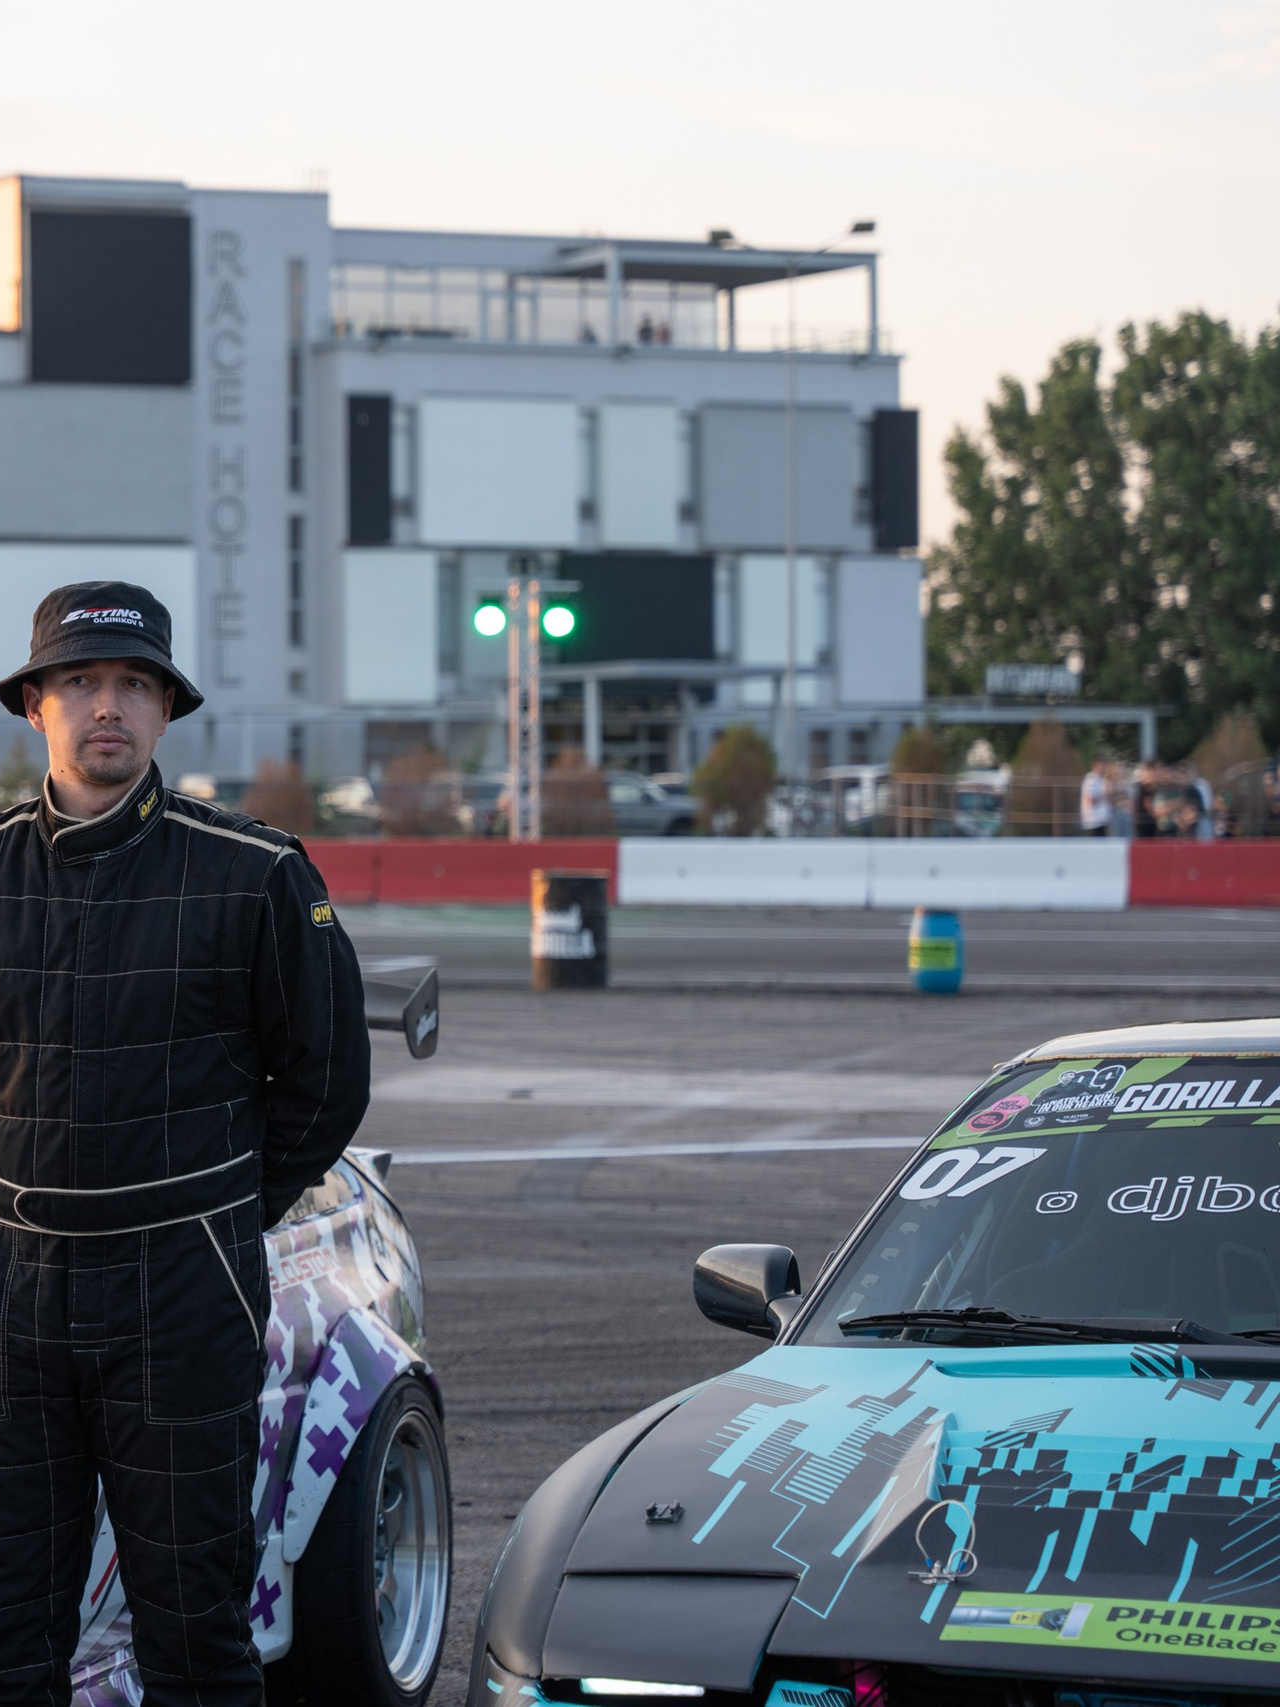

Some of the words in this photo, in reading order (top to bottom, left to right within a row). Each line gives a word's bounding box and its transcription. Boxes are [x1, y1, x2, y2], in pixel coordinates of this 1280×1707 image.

[207, 229, 249, 426] RACE
[207, 442, 251, 688] HOTEL
[93, 617, 137, 626] OLEINIKOV
[899, 1146, 1048, 1201] 07
[1115, 1628, 1278, 1654] OneBlade
